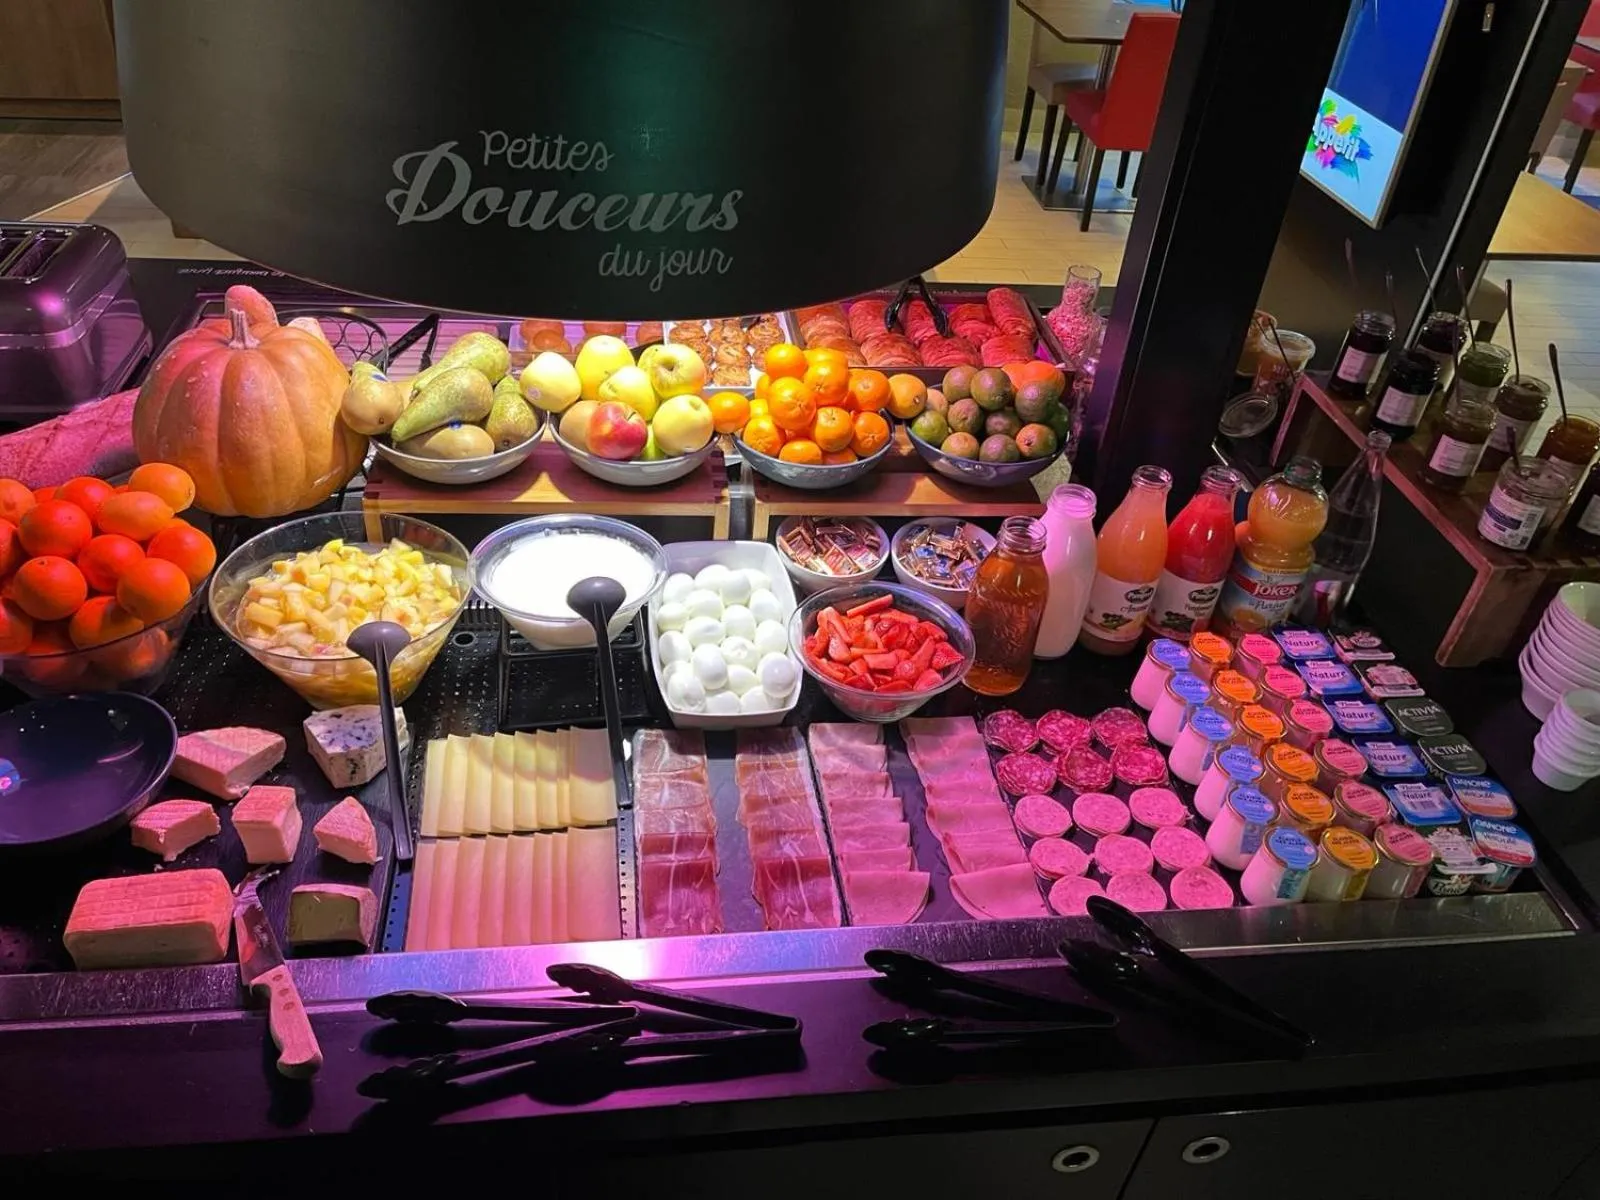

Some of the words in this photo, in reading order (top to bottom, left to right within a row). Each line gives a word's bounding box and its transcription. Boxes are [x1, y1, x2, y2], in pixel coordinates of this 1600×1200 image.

[479, 130, 615, 172] Petites
[385, 141, 744, 233] Douceurs
[599, 244, 653, 277] du
[651, 246, 734, 292] jour
[1284, 639, 1320, 647] Nature
[1309, 671, 1346, 679] Nature
[1398, 704, 1441, 717] ACTIVIA
[1337, 711, 1375, 719] Nature
[1368, 753, 1407, 761] Nature
[1402, 791, 1432, 799] Nature
